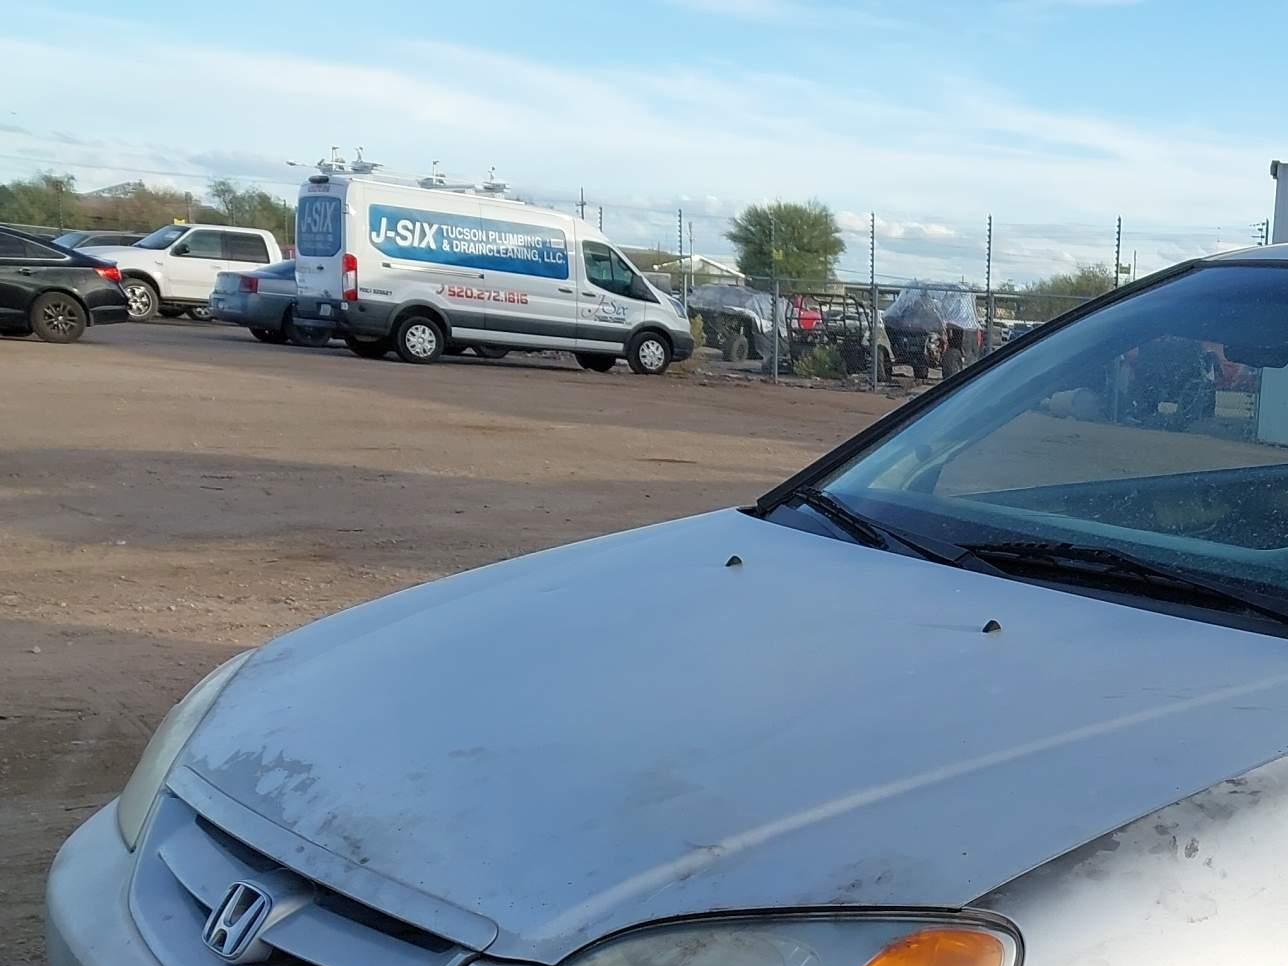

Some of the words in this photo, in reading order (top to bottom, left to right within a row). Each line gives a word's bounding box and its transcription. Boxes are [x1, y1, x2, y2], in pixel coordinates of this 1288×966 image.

[301, 201, 336, 233] J-SIX
[371, 216, 439, 250] J-SIX
[441, 225, 486, 241] TUCSON
[488, 231, 543, 248] PLUMBING
[442, 240, 450, 251] &
[447, 286, 528, 304] 520.272.1816
